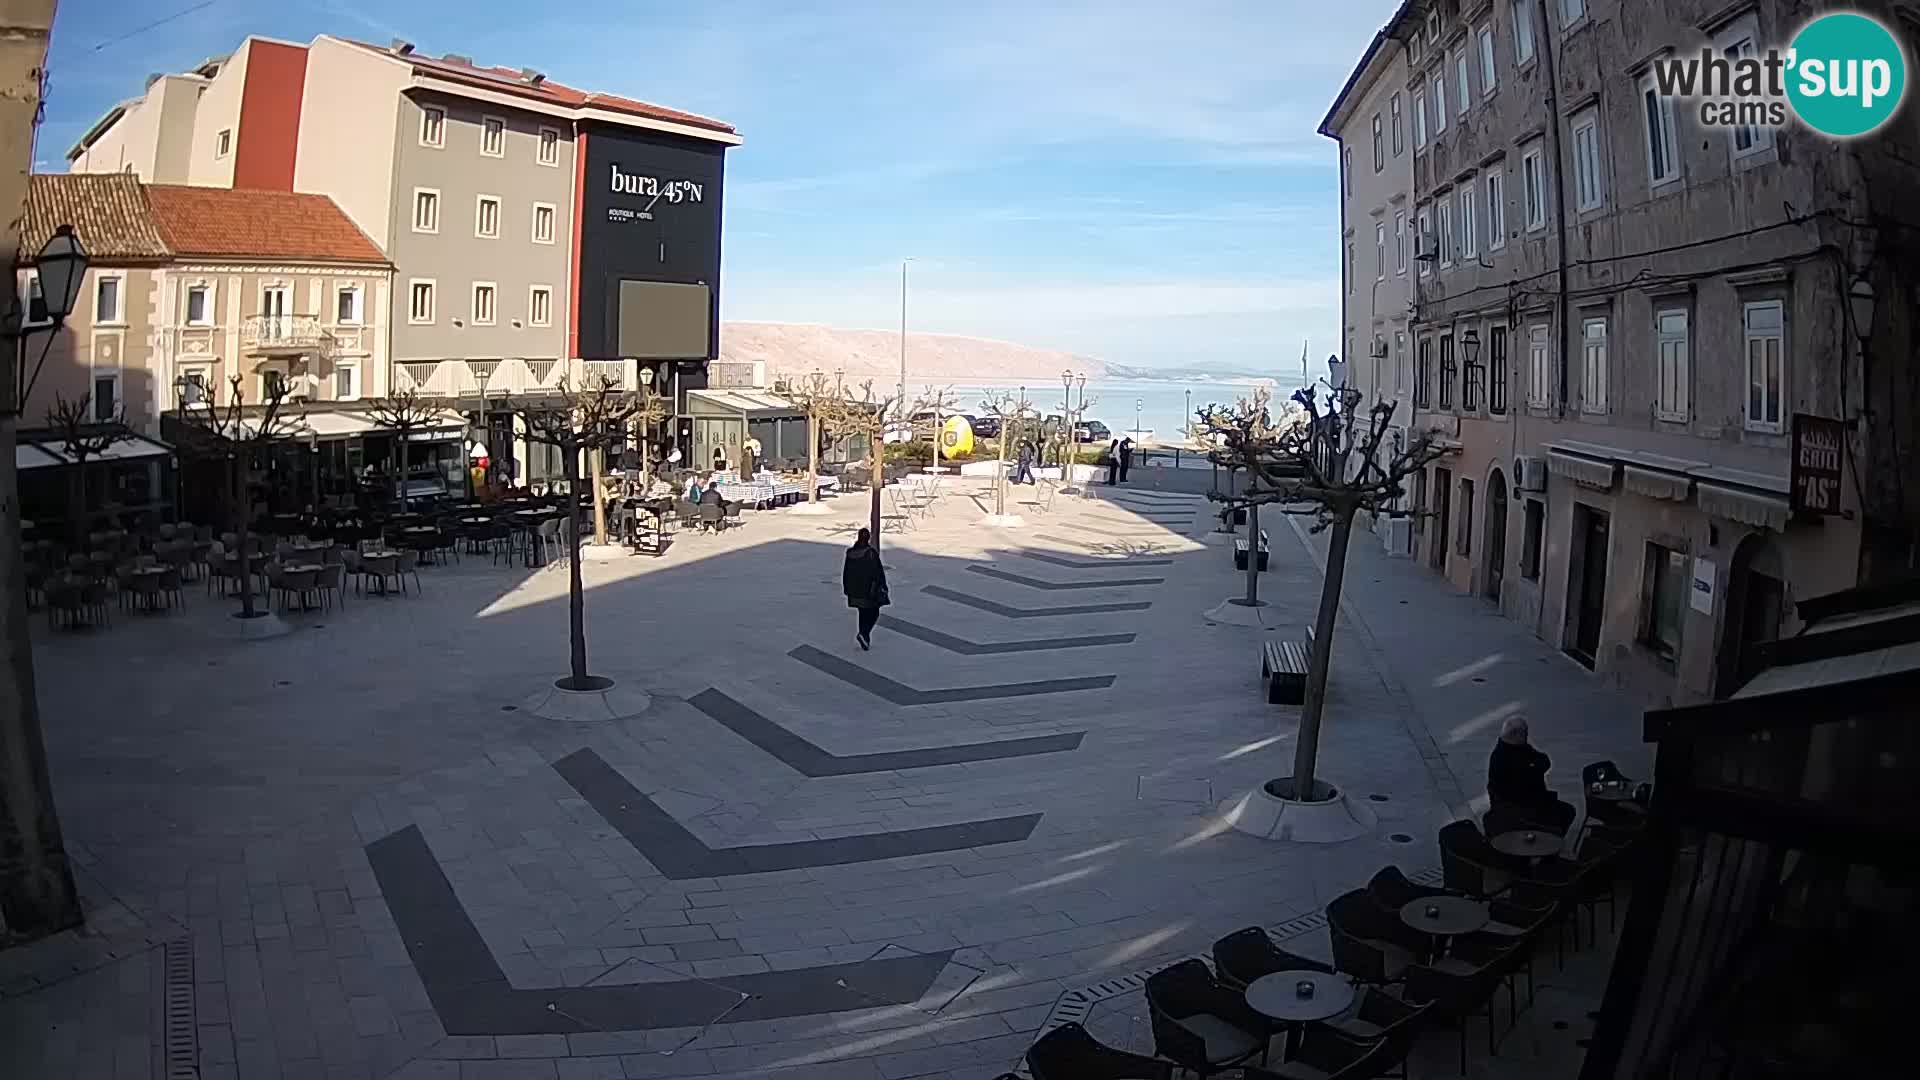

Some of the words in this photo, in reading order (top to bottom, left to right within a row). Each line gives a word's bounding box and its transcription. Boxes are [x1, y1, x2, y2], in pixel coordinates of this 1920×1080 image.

[611, 165, 658, 197] bura
[1800, 447, 1840, 471] GRILL
[1799, 474, 1839, 509] "AS"
